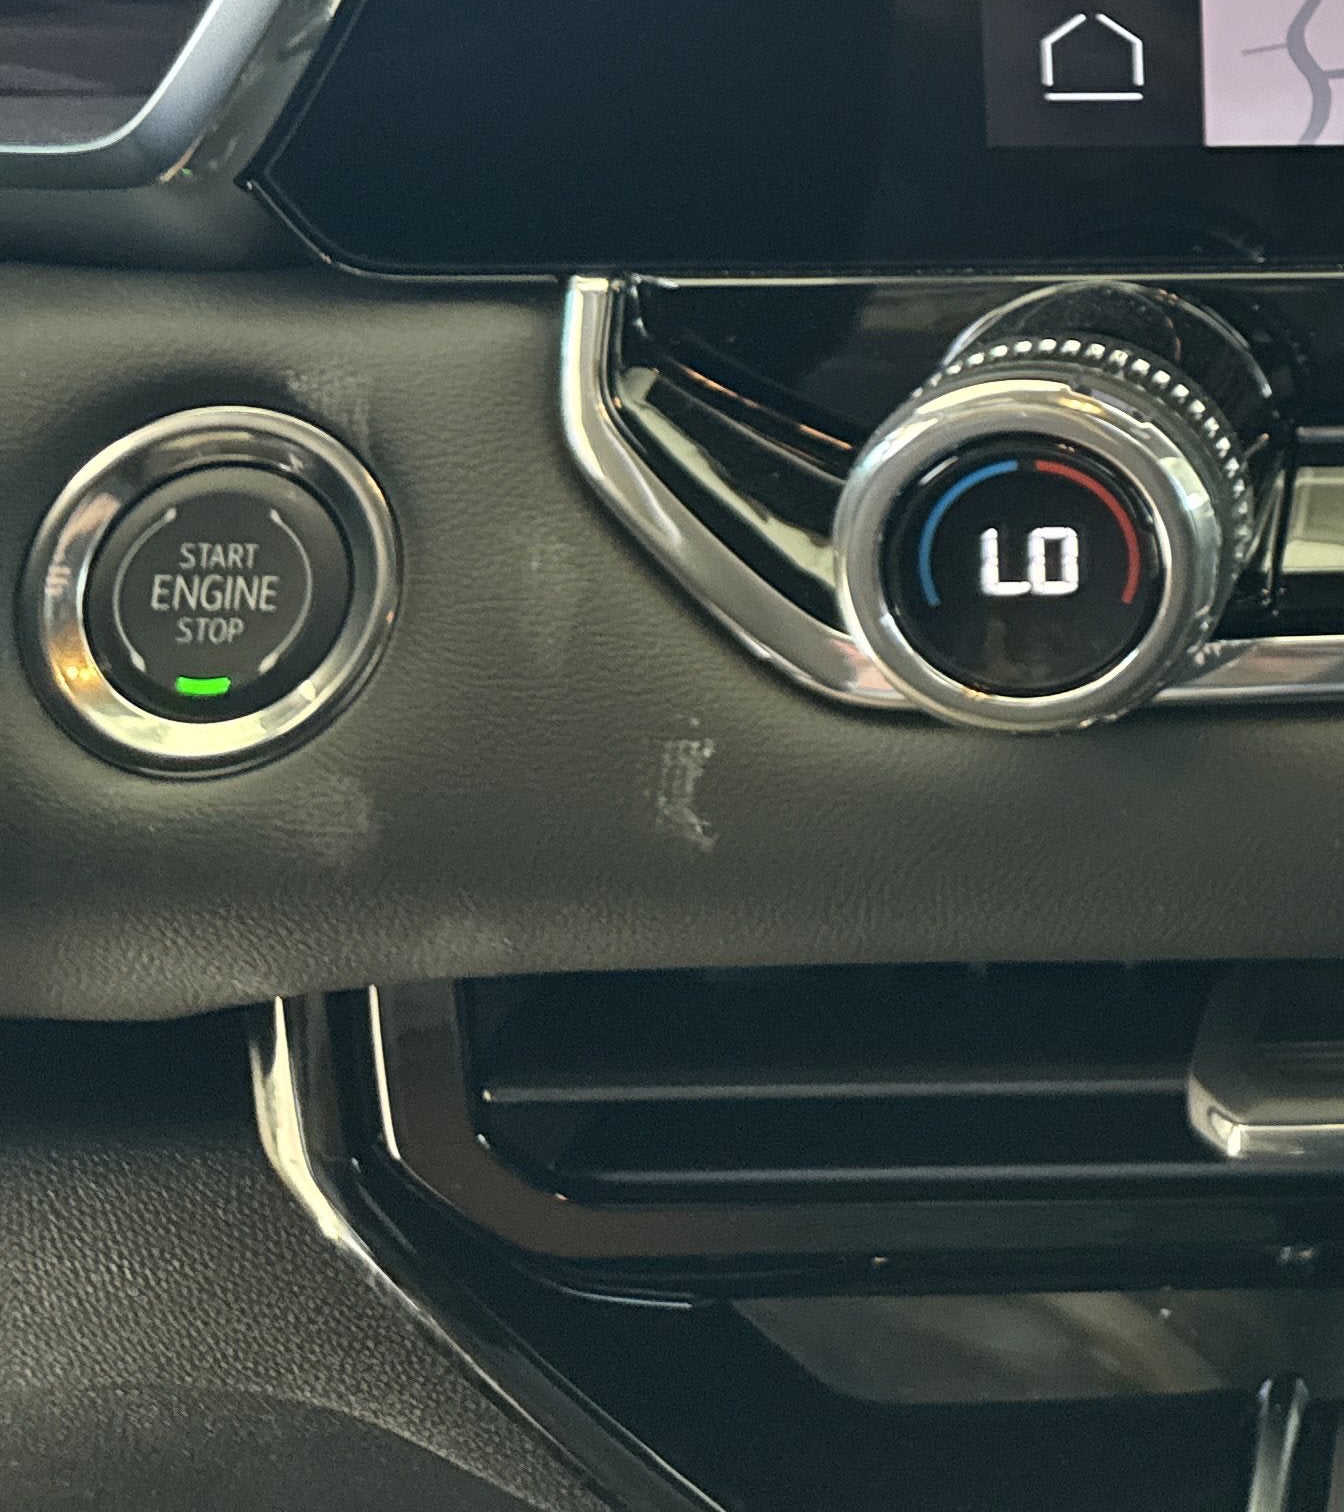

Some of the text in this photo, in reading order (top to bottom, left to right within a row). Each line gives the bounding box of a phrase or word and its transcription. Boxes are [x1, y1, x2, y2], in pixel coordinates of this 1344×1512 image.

[179, 543, 260, 571] START
[980, 527, 1079, 597] LO
[149, 573, 281, 613] ENGINE
[174, 616, 245, 645] STOP
